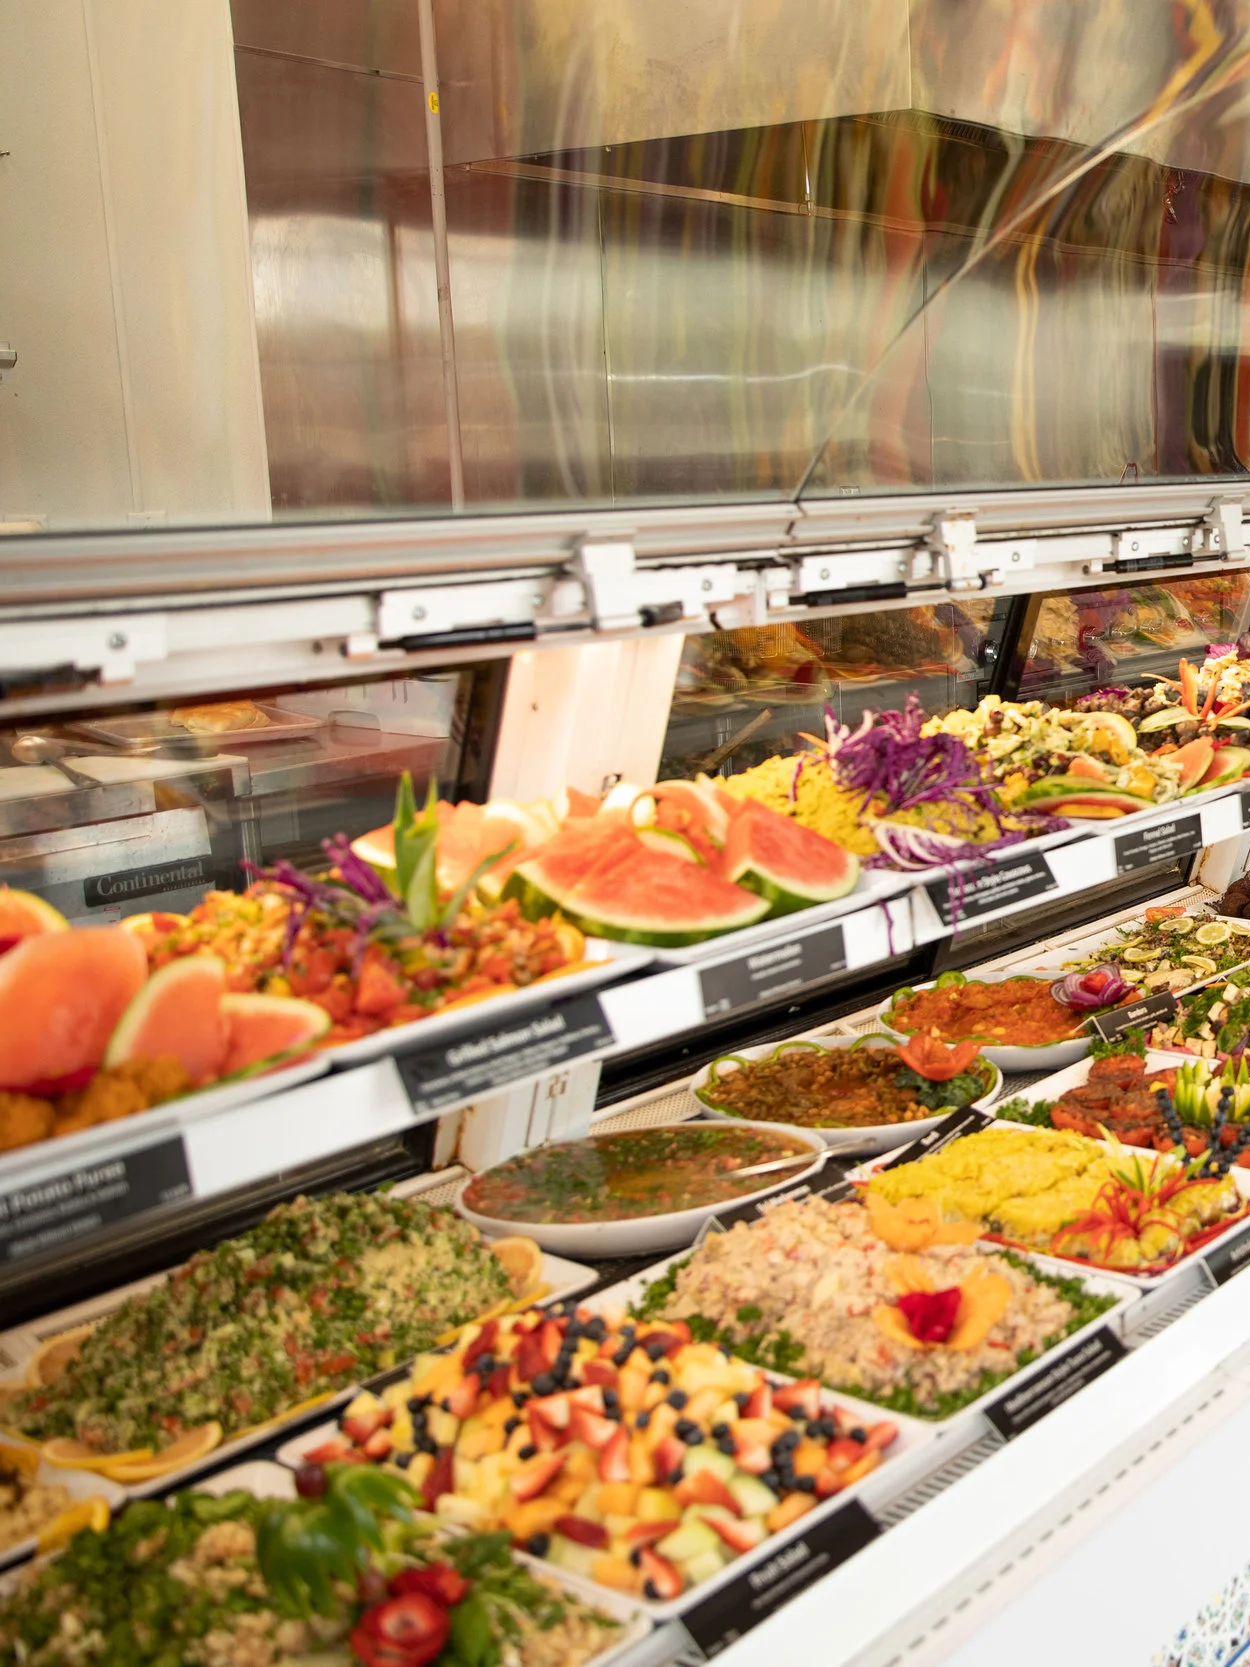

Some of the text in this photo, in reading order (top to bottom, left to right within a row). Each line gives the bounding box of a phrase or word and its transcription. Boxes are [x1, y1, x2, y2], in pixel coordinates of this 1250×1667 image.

[96, 861, 204, 896] Continental
[444, 1012, 567, 1068] Grilled Salmon Salad
[747, 1563, 778, 1592] Fruit
[775, 1541, 811, 1573] Salad
